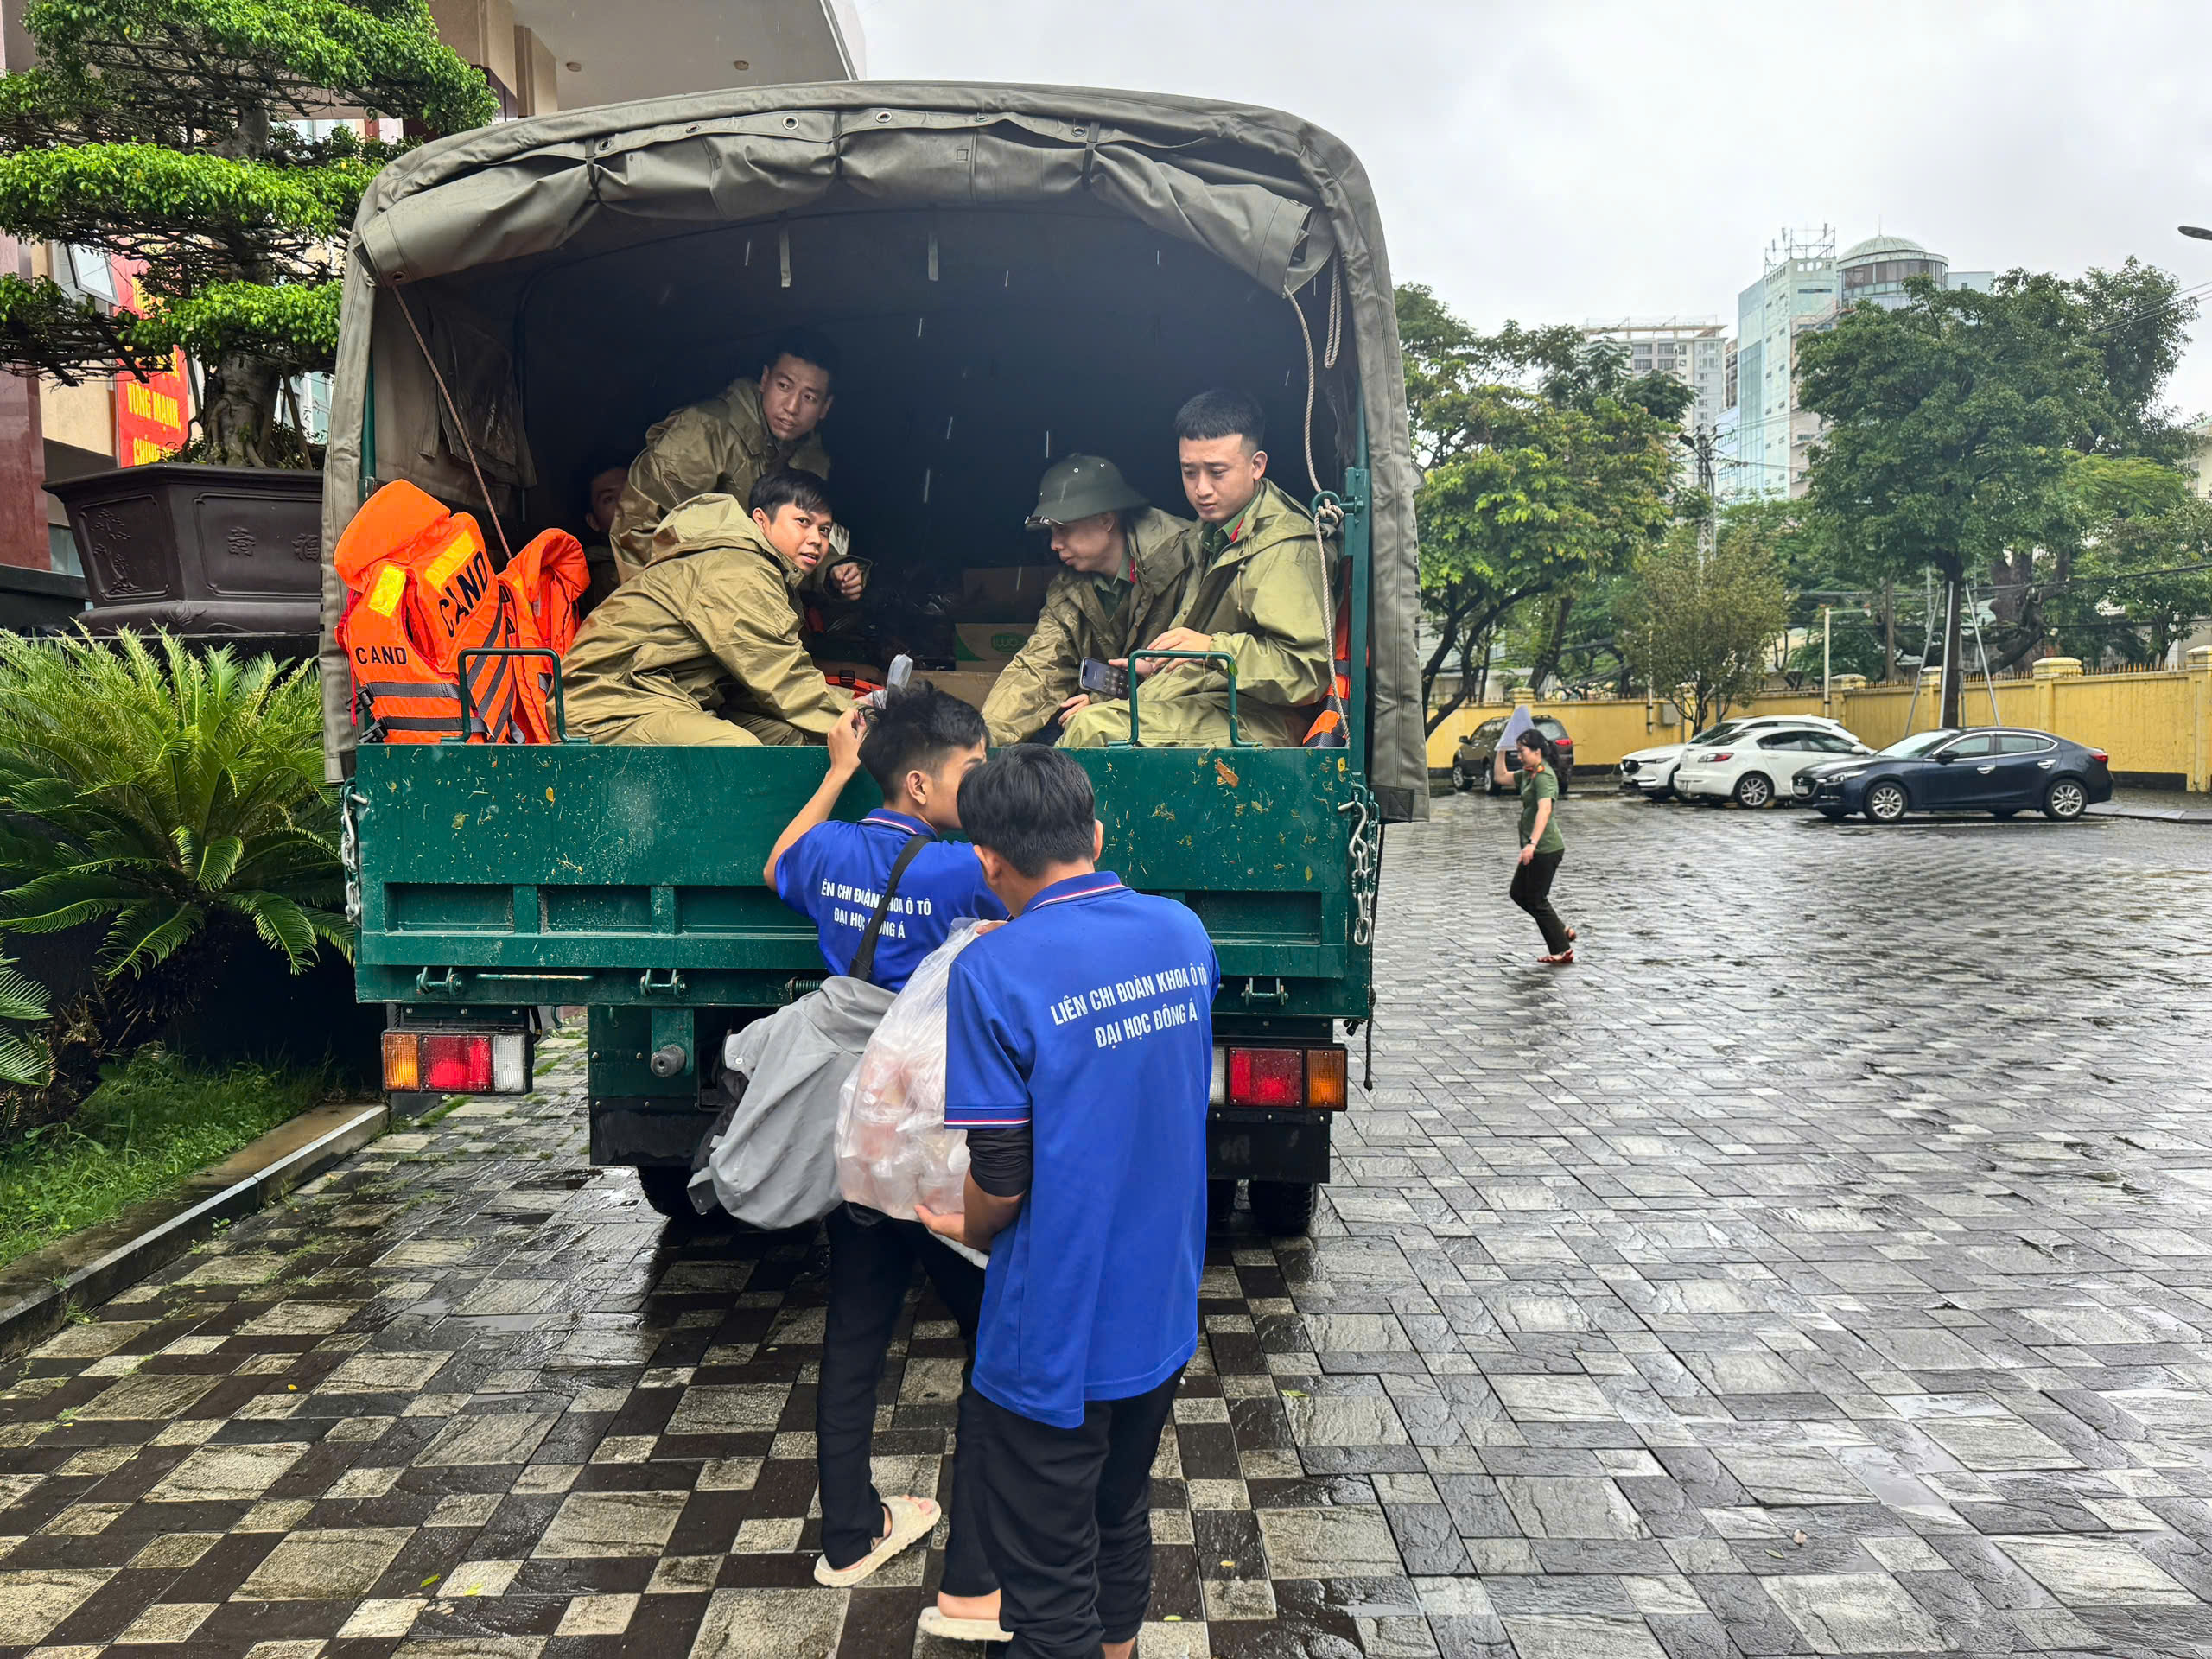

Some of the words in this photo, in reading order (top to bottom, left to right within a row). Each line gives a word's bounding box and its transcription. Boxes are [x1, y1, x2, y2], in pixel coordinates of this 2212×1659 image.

[439, 550, 488, 638] CAND
[355, 645, 407, 665] CAND
[821, 878, 836, 897] ÊN
[836, 883, 853, 901] CHI
[882, 895, 904, 913] HOA
[906, 896, 914, 915] Ô
[917, 898, 931, 916] TÔ
[834, 907, 848, 926] ĐẠI
[897, 920, 906, 938] Á
[1050, 995, 1089, 1026] LIÊN
[1089, 986, 1116, 1011] CHI
[1116, 975, 1156, 1003] ĐOÀN
[1155, 967, 1190, 993] KHOA
[1190, 963, 1198, 987] Ô
[1094, 1021, 1122, 1049] ĐẠI
[1122, 1013, 1152, 1040] HỌC
[1153, 1003, 1186, 1031] ĐÔNG
[1189, 997, 1198, 1021] Á
